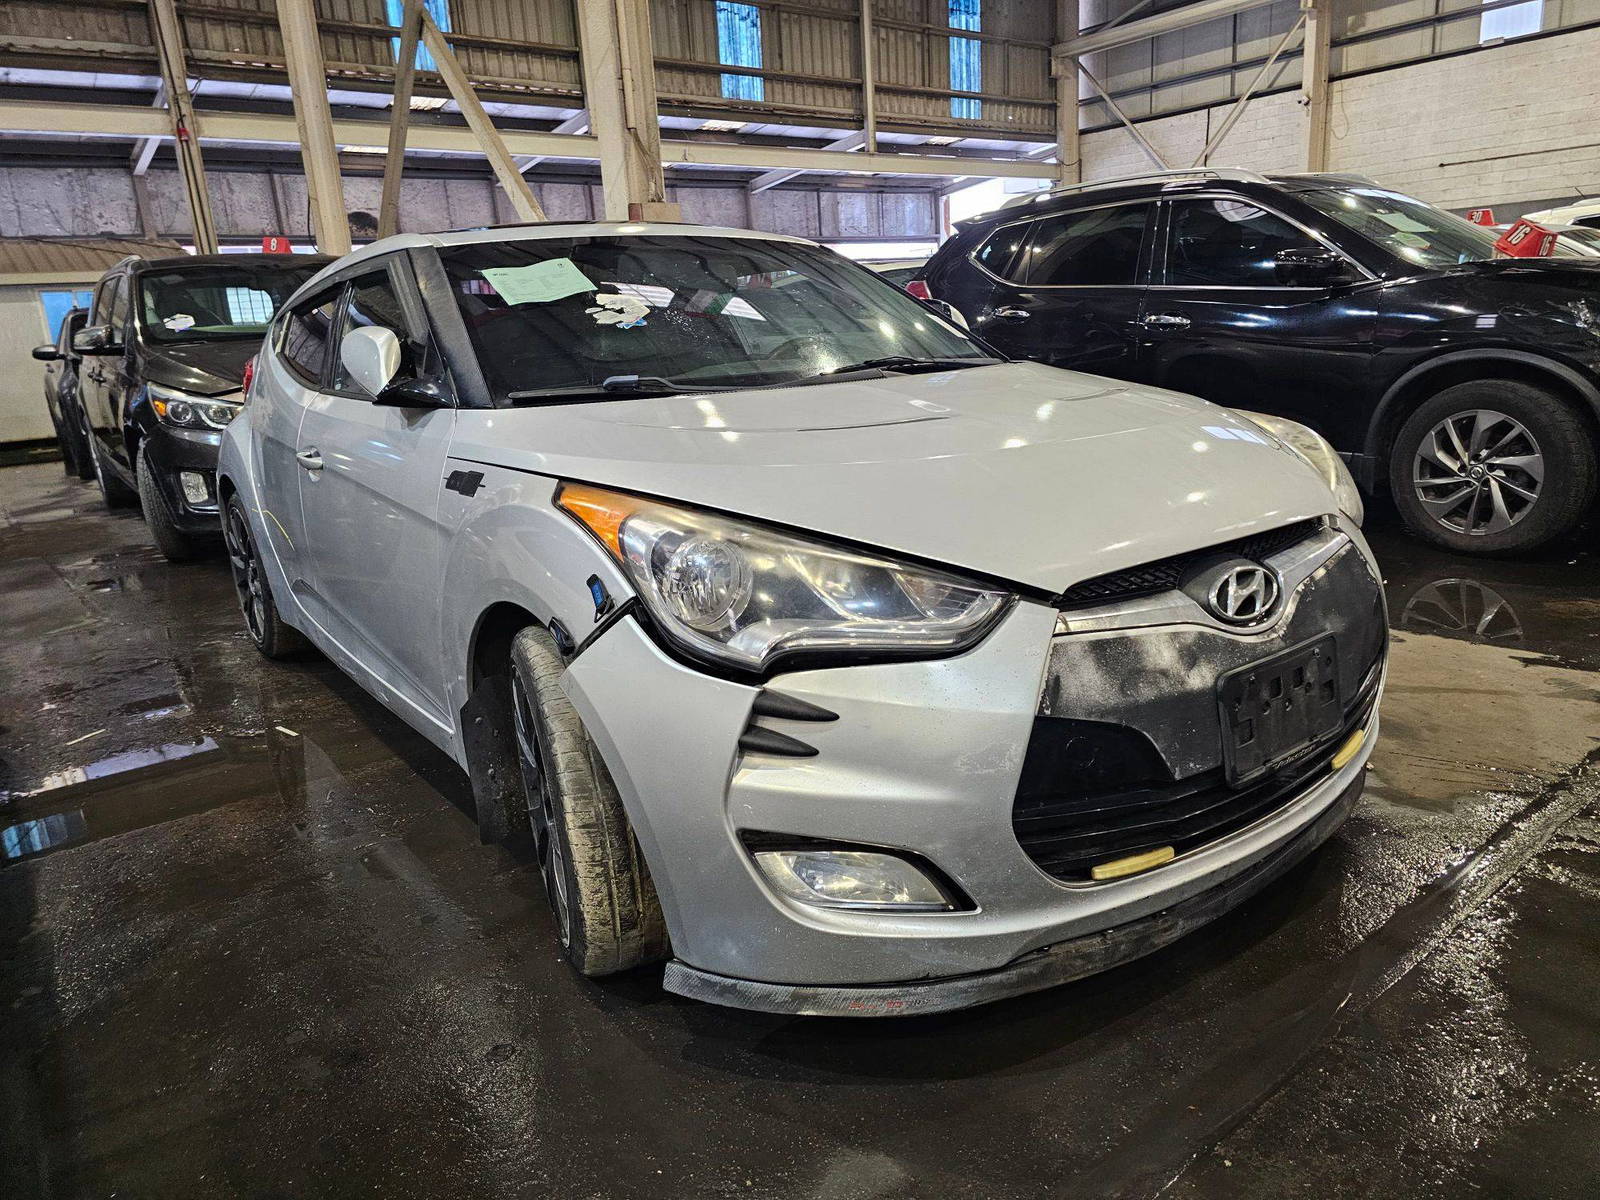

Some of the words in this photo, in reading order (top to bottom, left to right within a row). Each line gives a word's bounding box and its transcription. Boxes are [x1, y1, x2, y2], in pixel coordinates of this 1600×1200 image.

[1471, 211, 1483, 224] 30
[1507, 224, 1531, 245] 16
[270, 238, 277, 251] 8
[1539, 235, 1553, 256] 16
